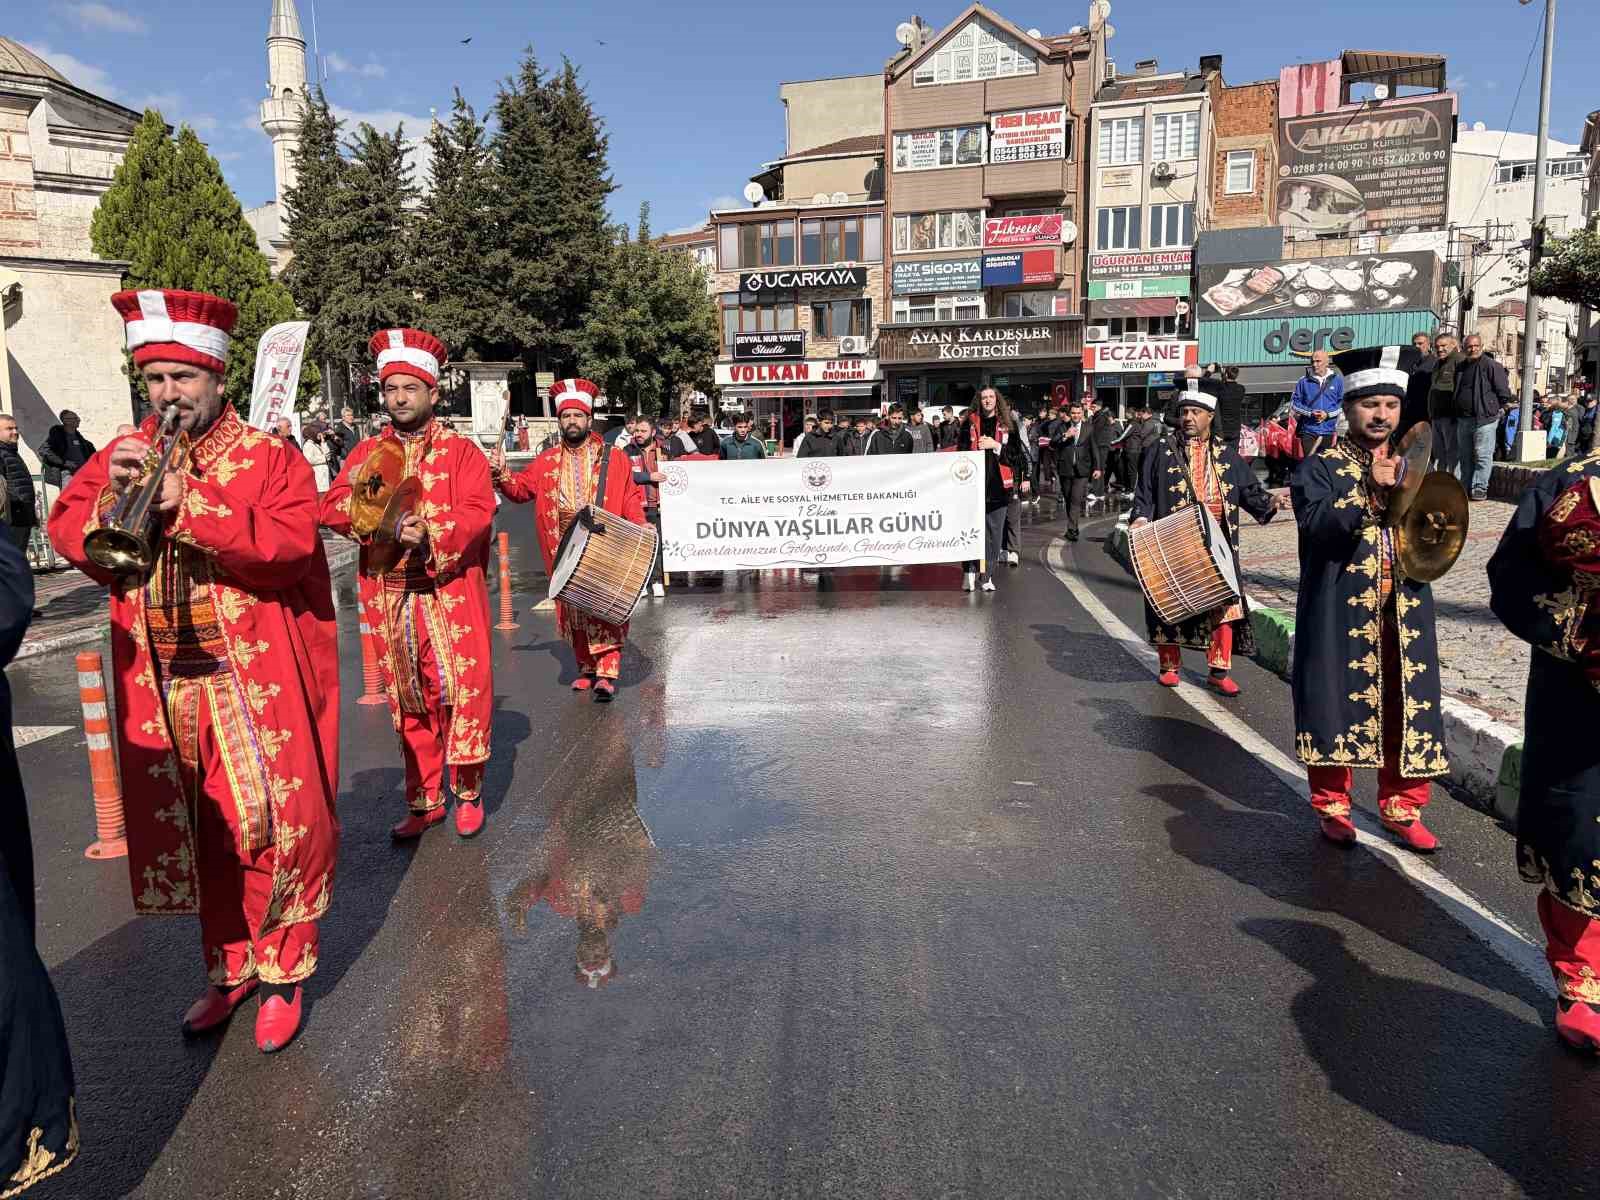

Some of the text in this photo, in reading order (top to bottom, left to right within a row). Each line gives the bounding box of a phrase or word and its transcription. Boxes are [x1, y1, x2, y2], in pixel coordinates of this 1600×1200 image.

[1318, 162, 1335, 172] 214
[1337, 160, 1349, 170] 00
[1352, 158, 1363, 169] 90
[1419, 151, 1431, 162] 00
[1433, 149, 1446, 160] 90
[894, 263, 920, 273] ANT
[763, 335, 778, 343] NUR
[908, 326, 1052, 345] AYAN KARDEŞLER
[1263, 320, 1356, 354] dere
[938, 341, 1021, 360] KÖFTECİSİ
[1099, 344, 1181, 361] ECZANE
[729, 363, 809, 383] VOLKAN
[826, 360, 862, 370] ET VE ET
[1121, 361, 1157, 369] MEYDAN
[740, 494, 761, 504] AİLE
[763, 495, 775, 503] VE
[776, 494, 811, 503] SOSYAL
[813, 493, 864, 502] HİZMETLER
[866, 490, 917, 500] BAKANLIĞI
[806, 503, 838, 517] Ekim
[696, 510, 943, 540] DÜNYA YAŞLILAR GÜNÜ
